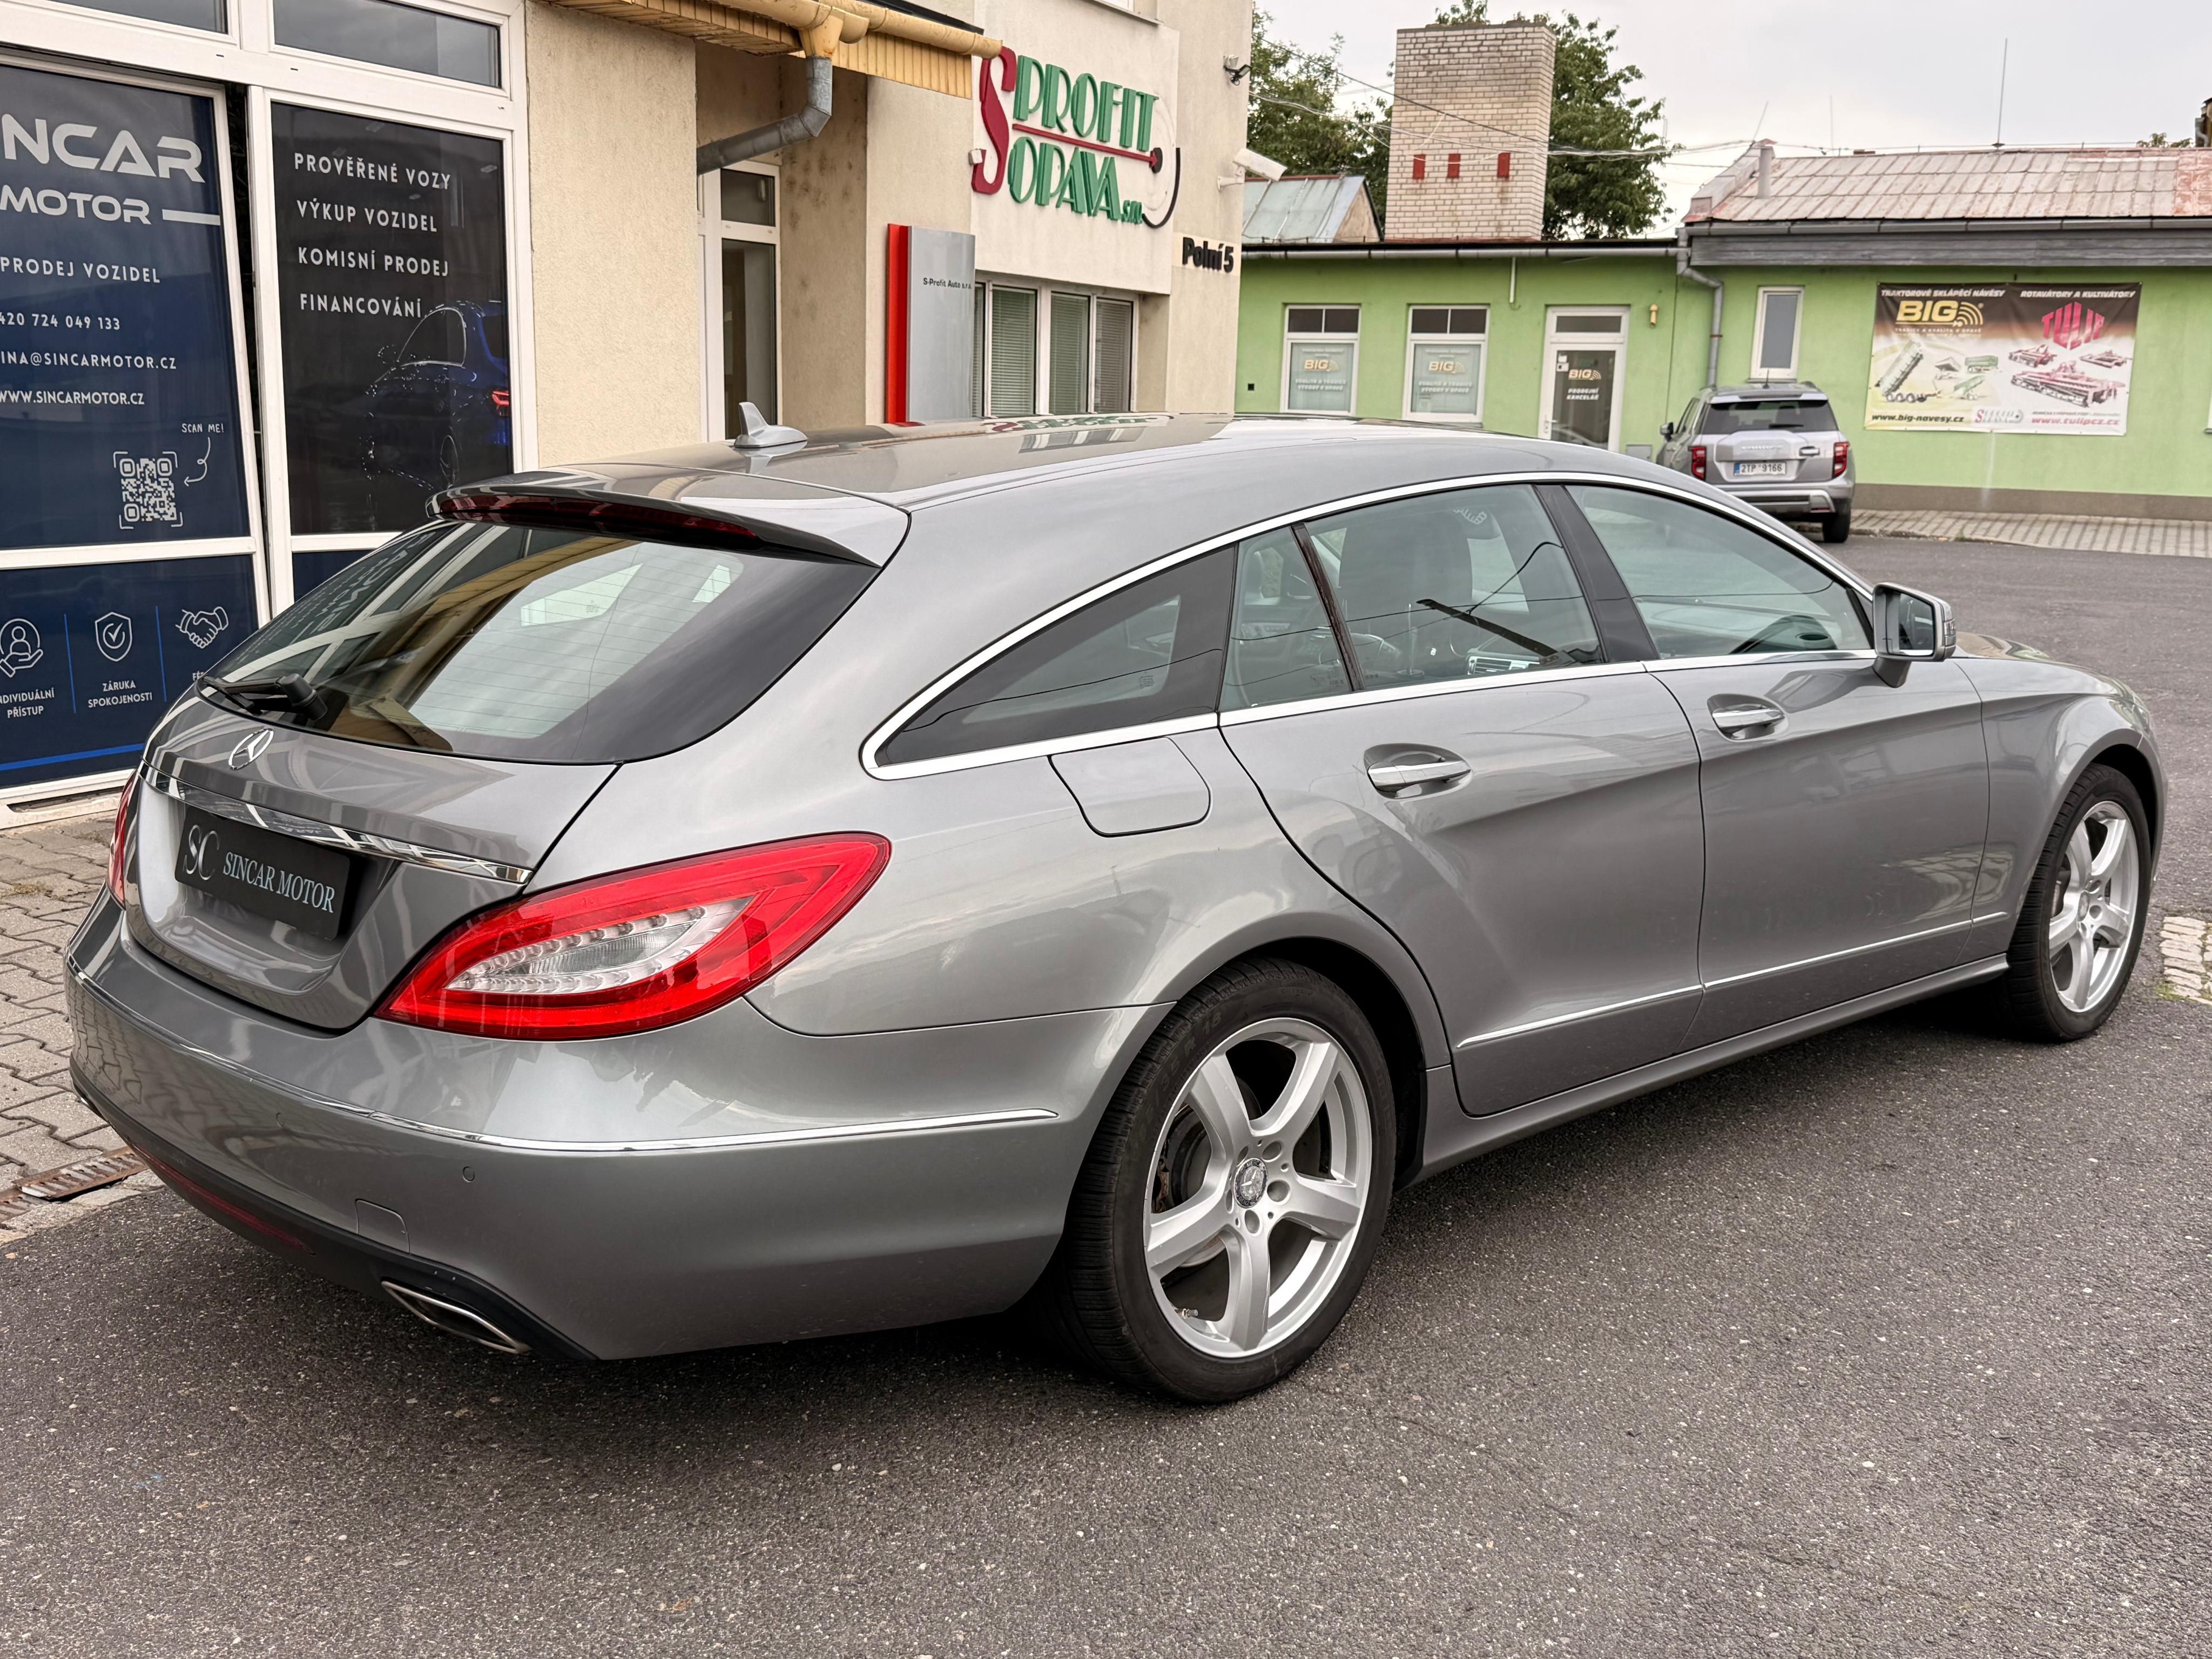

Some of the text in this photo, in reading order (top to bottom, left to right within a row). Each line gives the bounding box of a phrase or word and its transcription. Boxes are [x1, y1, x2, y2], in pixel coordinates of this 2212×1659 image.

[1013, 55, 1159, 152] PROFIT
[294, 152, 451, 190] PROVĚŘENÉ VOZY
[1008, 136, 1122, 221] OPAVA
[0, 184, 152, 225] MOTOR
[296, 198, 437, 233] VÝKUP VOZIDEL
[298, 246, 449, 277] KOMISNÍ PRODEJ
[1182, 237, 1235, 273] Polní 5
[0, 257, 161, 284] PRODEJ VOZIDEL
[923, 277, 947, 287] S-Profit
[947, 279, 961, 289] Auto
[1881, 288, 1932, 296] TRAKTOROVÉ
[1972, 289, 2006, 297] NÁVĚSY
[2020, 289, 2073, 298] ROTAVÁTORY
[2082, 289, 2136, 298] KULTIVÁTORY
[300, 293, 422, 318] FINANCOVÁNÍ
[1896, 300, 1959, 322] BIG
[31, 313, 58, 327] 724
[65, 315, 91, 329] 049
[98, 316, 120, 330] 133
[1304, 359, 1329, 370] BIG
[1428, 361, 1454, 372] BIG
[1568, 369, 1593, 379] BIG
[0, 390, 145, 405] WWW.SINCARMOTOR.CZ
[1871, 413, 1965, 423] www.big-navesy.cz
[2031, 417, 2120, 426] www.tulipcz.cz
[181, 423, 225, 433] SCAN ME!
[1741, 464, 1756, 473] 2TP
[102, 679, 137, 692] ZÁRUKA
[88, 692, 153, 708] SPOKOJENOSTI
[7, 705, 44, 718] PŘÍSTUP
[222, 851, 335, 914] SINCAR MOTOR
